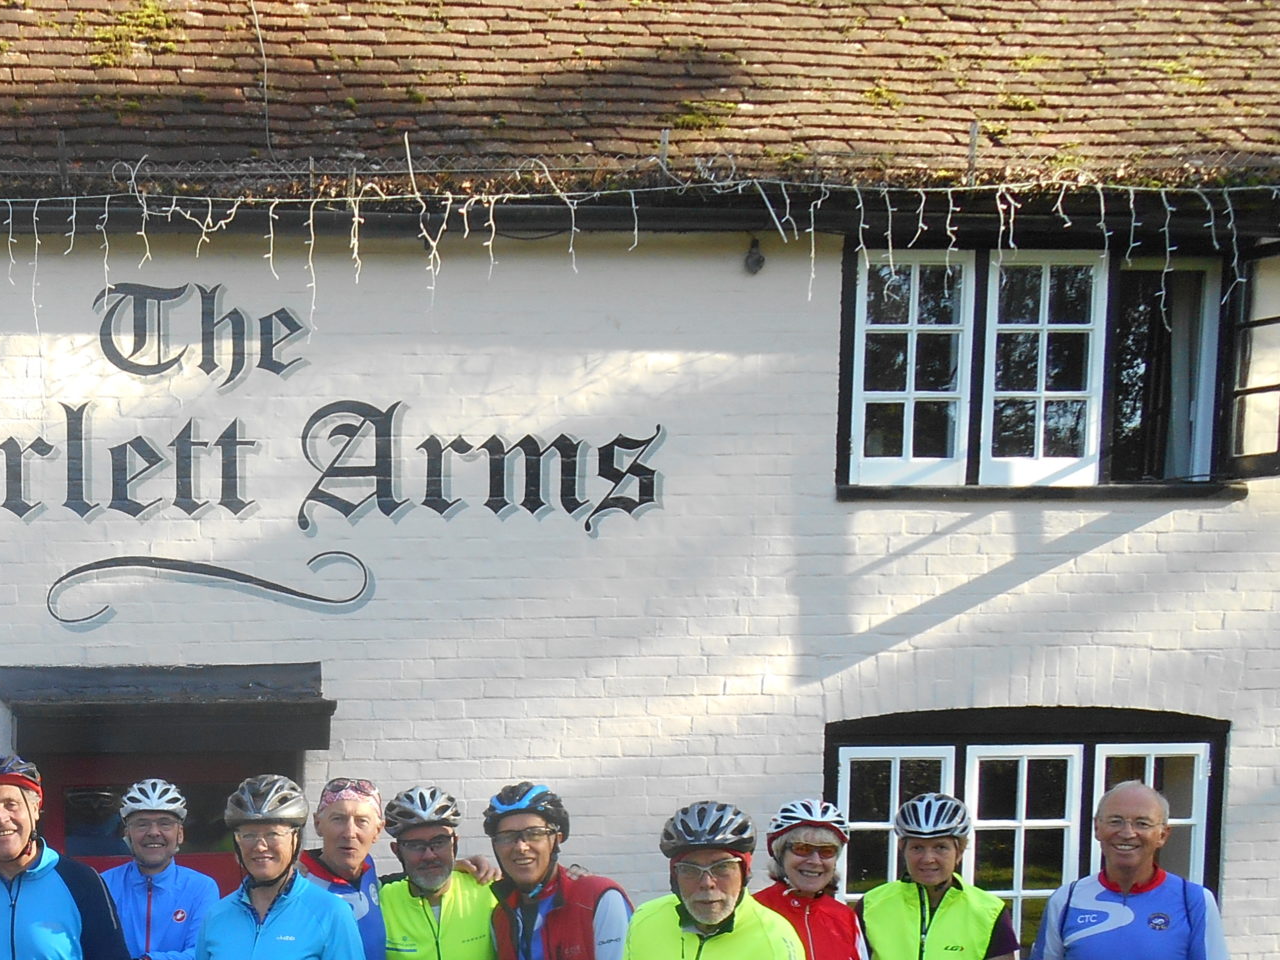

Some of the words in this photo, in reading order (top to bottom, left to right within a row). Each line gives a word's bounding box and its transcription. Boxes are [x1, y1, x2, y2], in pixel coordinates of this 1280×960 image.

[92, 281, 310, 388] The
[297, 400, 667, 534] Arms
[1077, 914, 1098, 924] CTC
